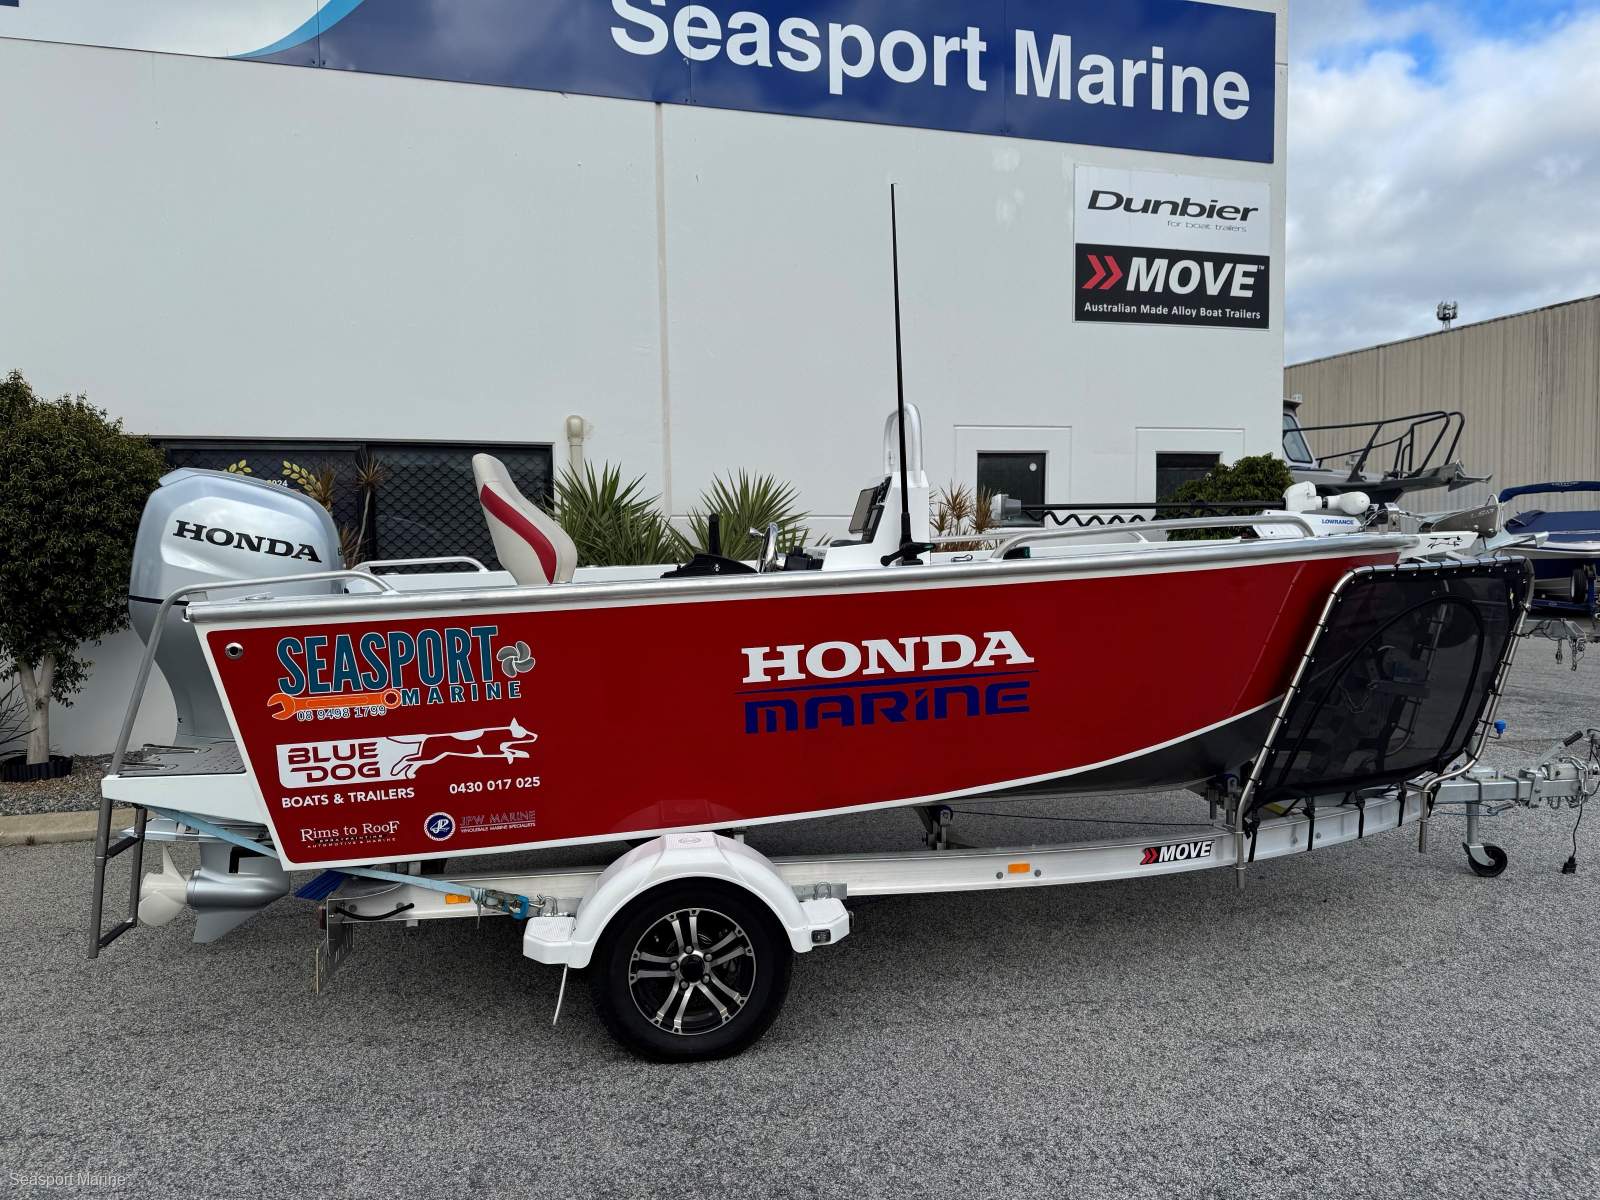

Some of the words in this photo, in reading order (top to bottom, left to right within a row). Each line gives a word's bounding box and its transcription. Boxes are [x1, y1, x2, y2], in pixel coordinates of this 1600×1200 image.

[609, 0, 988, 96] Seasport
[1014, 29, 1251, 121] Marine
[1087, 190, 1259, 222] Dunbier
[1167, 220, 1182, 229] for
[1185, 221, 1211, 230] boat
[1215, 223, 1247, 233] trailers
[1126, 256, 1258, 298] MOVE
[1084, 302, 1137, 314] Australian
[1140, 304, 1169, 315] Made
[1171, 305, 1197, 318] Alloy
[1200, 307, 1223, 317] Boat
[1225, 308, 1261, 320] Trailers
[1321, 518, 1354, 526] LOWRANCE
[172, 520, 322, 563] HONDA
[276, 625, 498, 696] SEASPORT
[741, 630, 1035, 684] HONDA
[400, 680, 522, 707] MARINE
[296, 709, 314, 721] 08
[316, 707, 351, 720] 9498
[354, 705, 388, 719] 1799
[744, 680, 1031, 735] MARINE
[287, 741, 378, 765] BLUE
[290, 761, 381, 783] DOG
[449, 781, 483, 795] 0430
[488, 779, 511, 791] 017
[515, 776, 541, 789] 025
[281, 794, 329, 809] BOATS
[333, 793, 345, 804] &
[347, 787, 416, 803] TRAILERS
[489, 810, 536, 823] MARINE
[300, 827, 340, 842] Rims
[343, 825, 358, 835] to
[1158, 840, 1212, 863] MOVE
